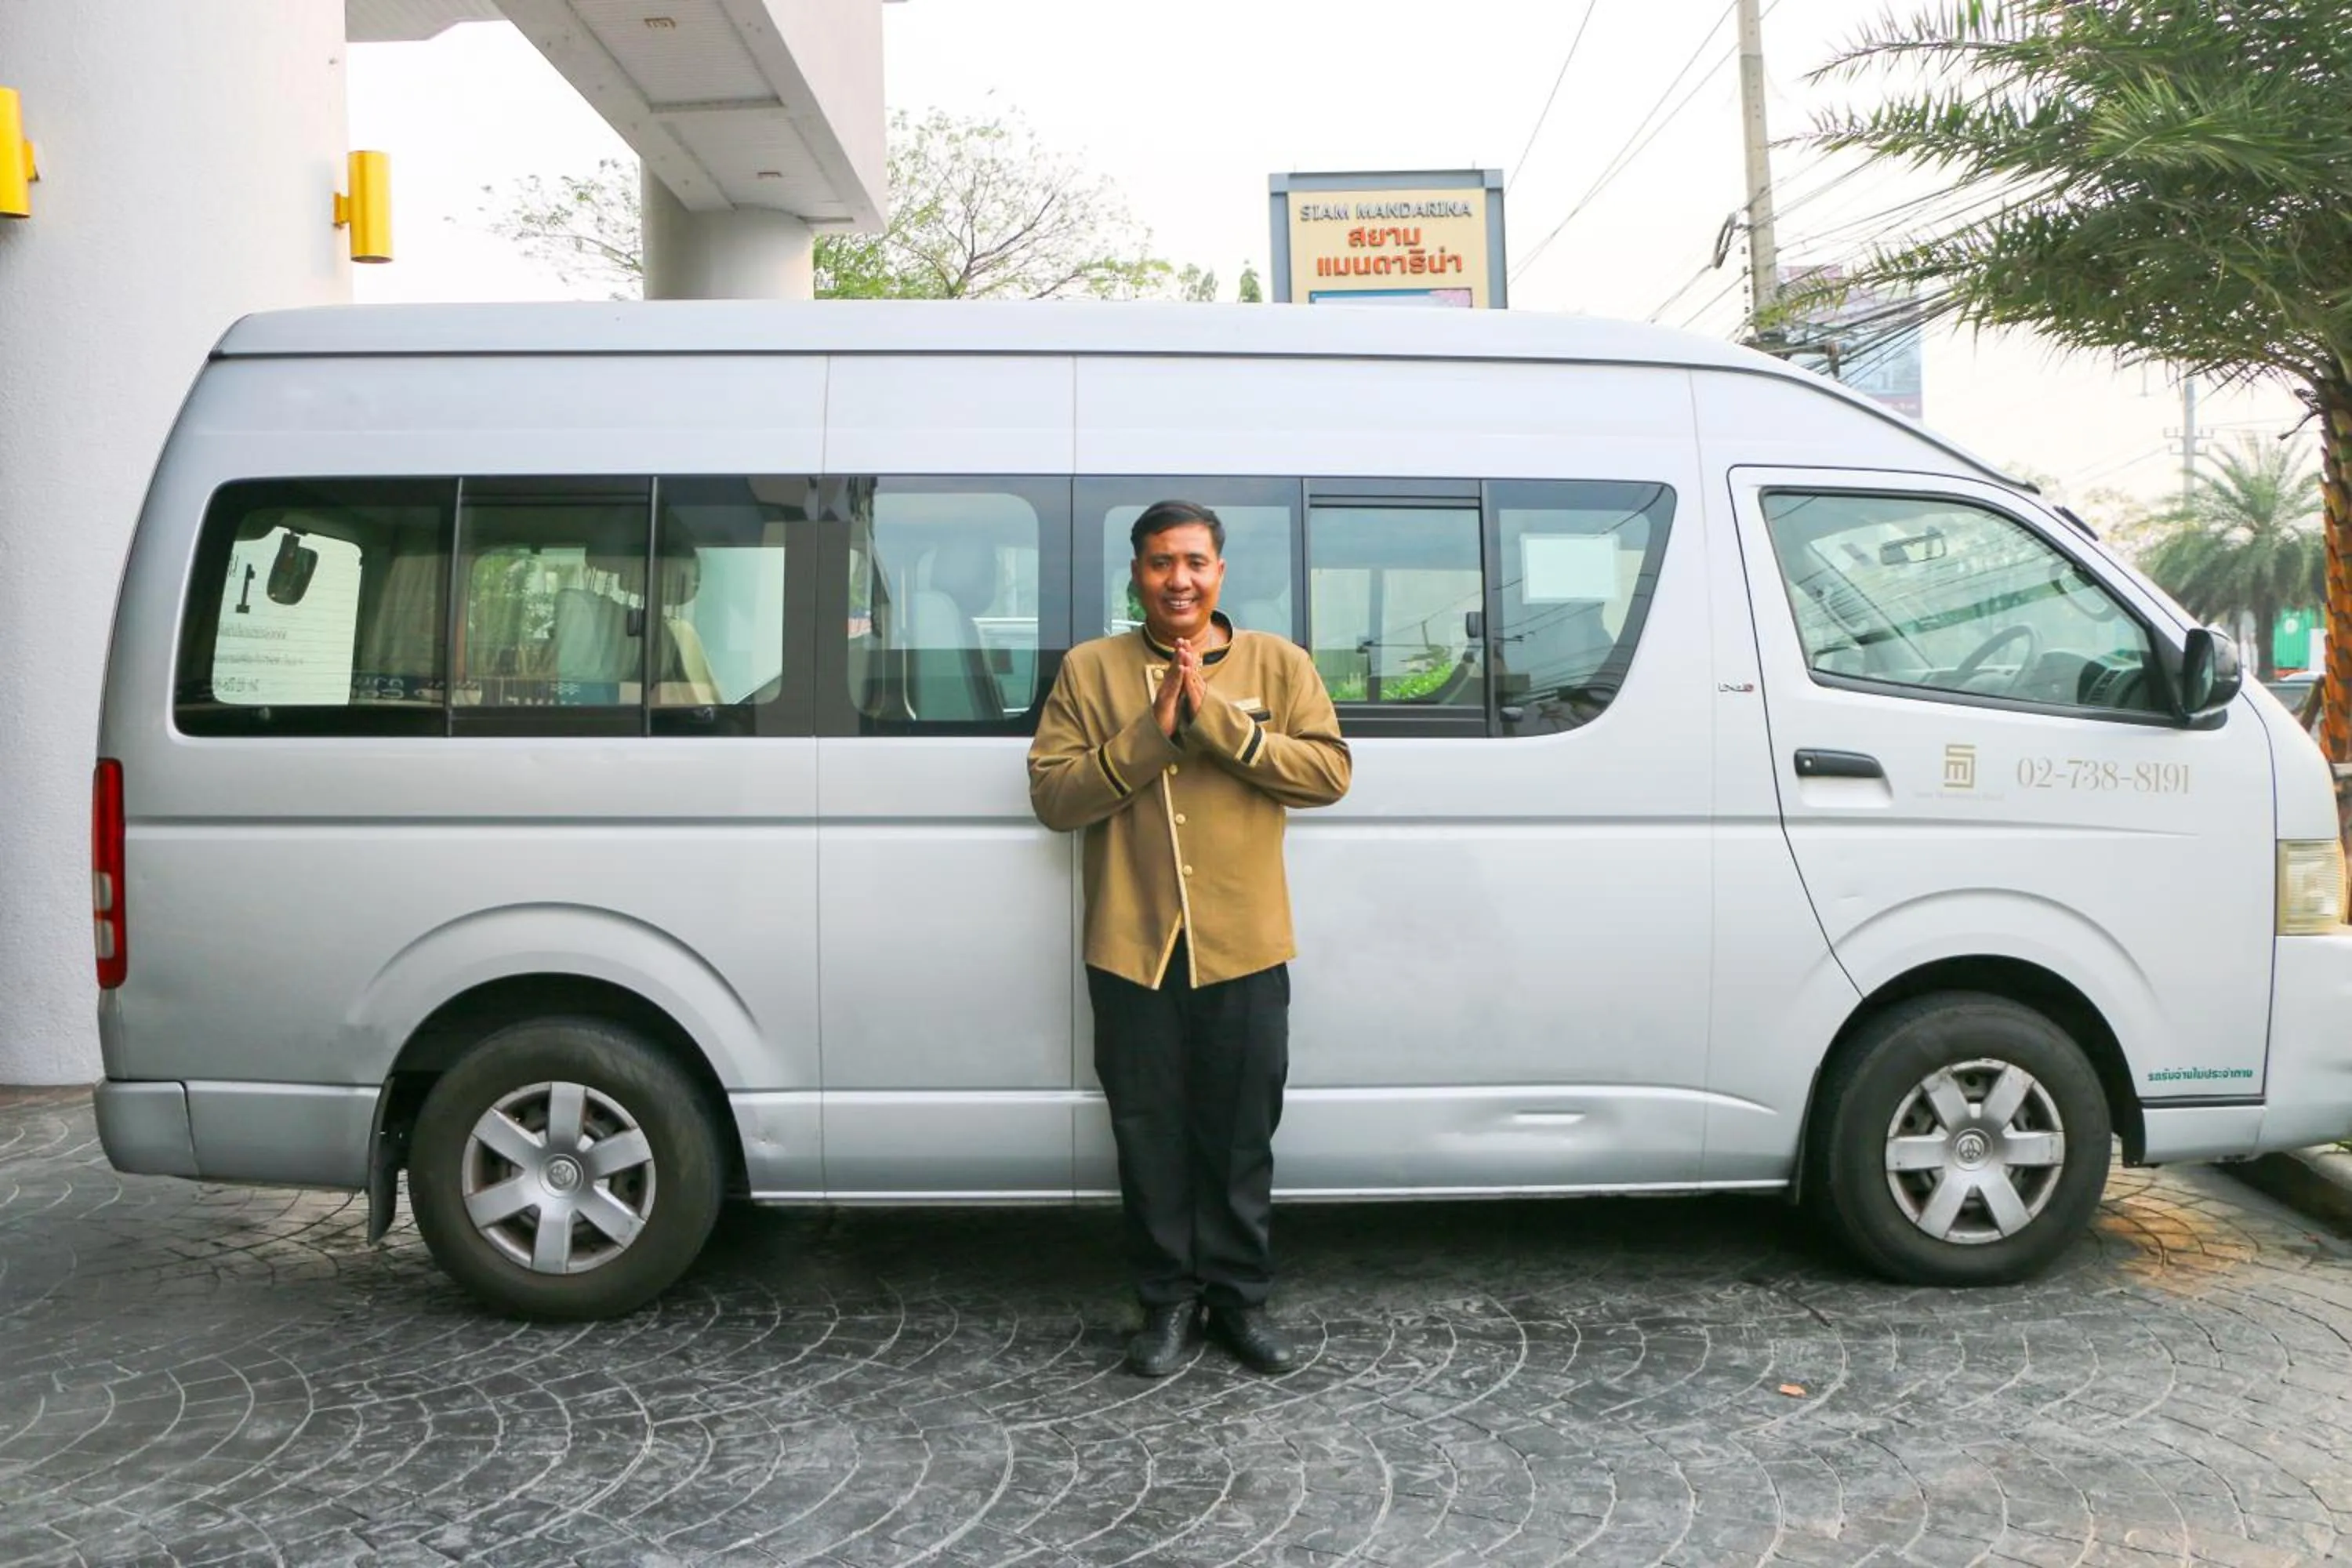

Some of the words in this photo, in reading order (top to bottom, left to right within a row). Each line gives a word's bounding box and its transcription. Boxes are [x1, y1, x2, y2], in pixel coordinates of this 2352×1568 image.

[1300, 203, 1350, 221] SIAM
[1356, 200, 1472, 220] MANDARINA
[1348, 227, 1421, 248] สยาม
[2016, 757, 2190, 794] 02-738-8191
